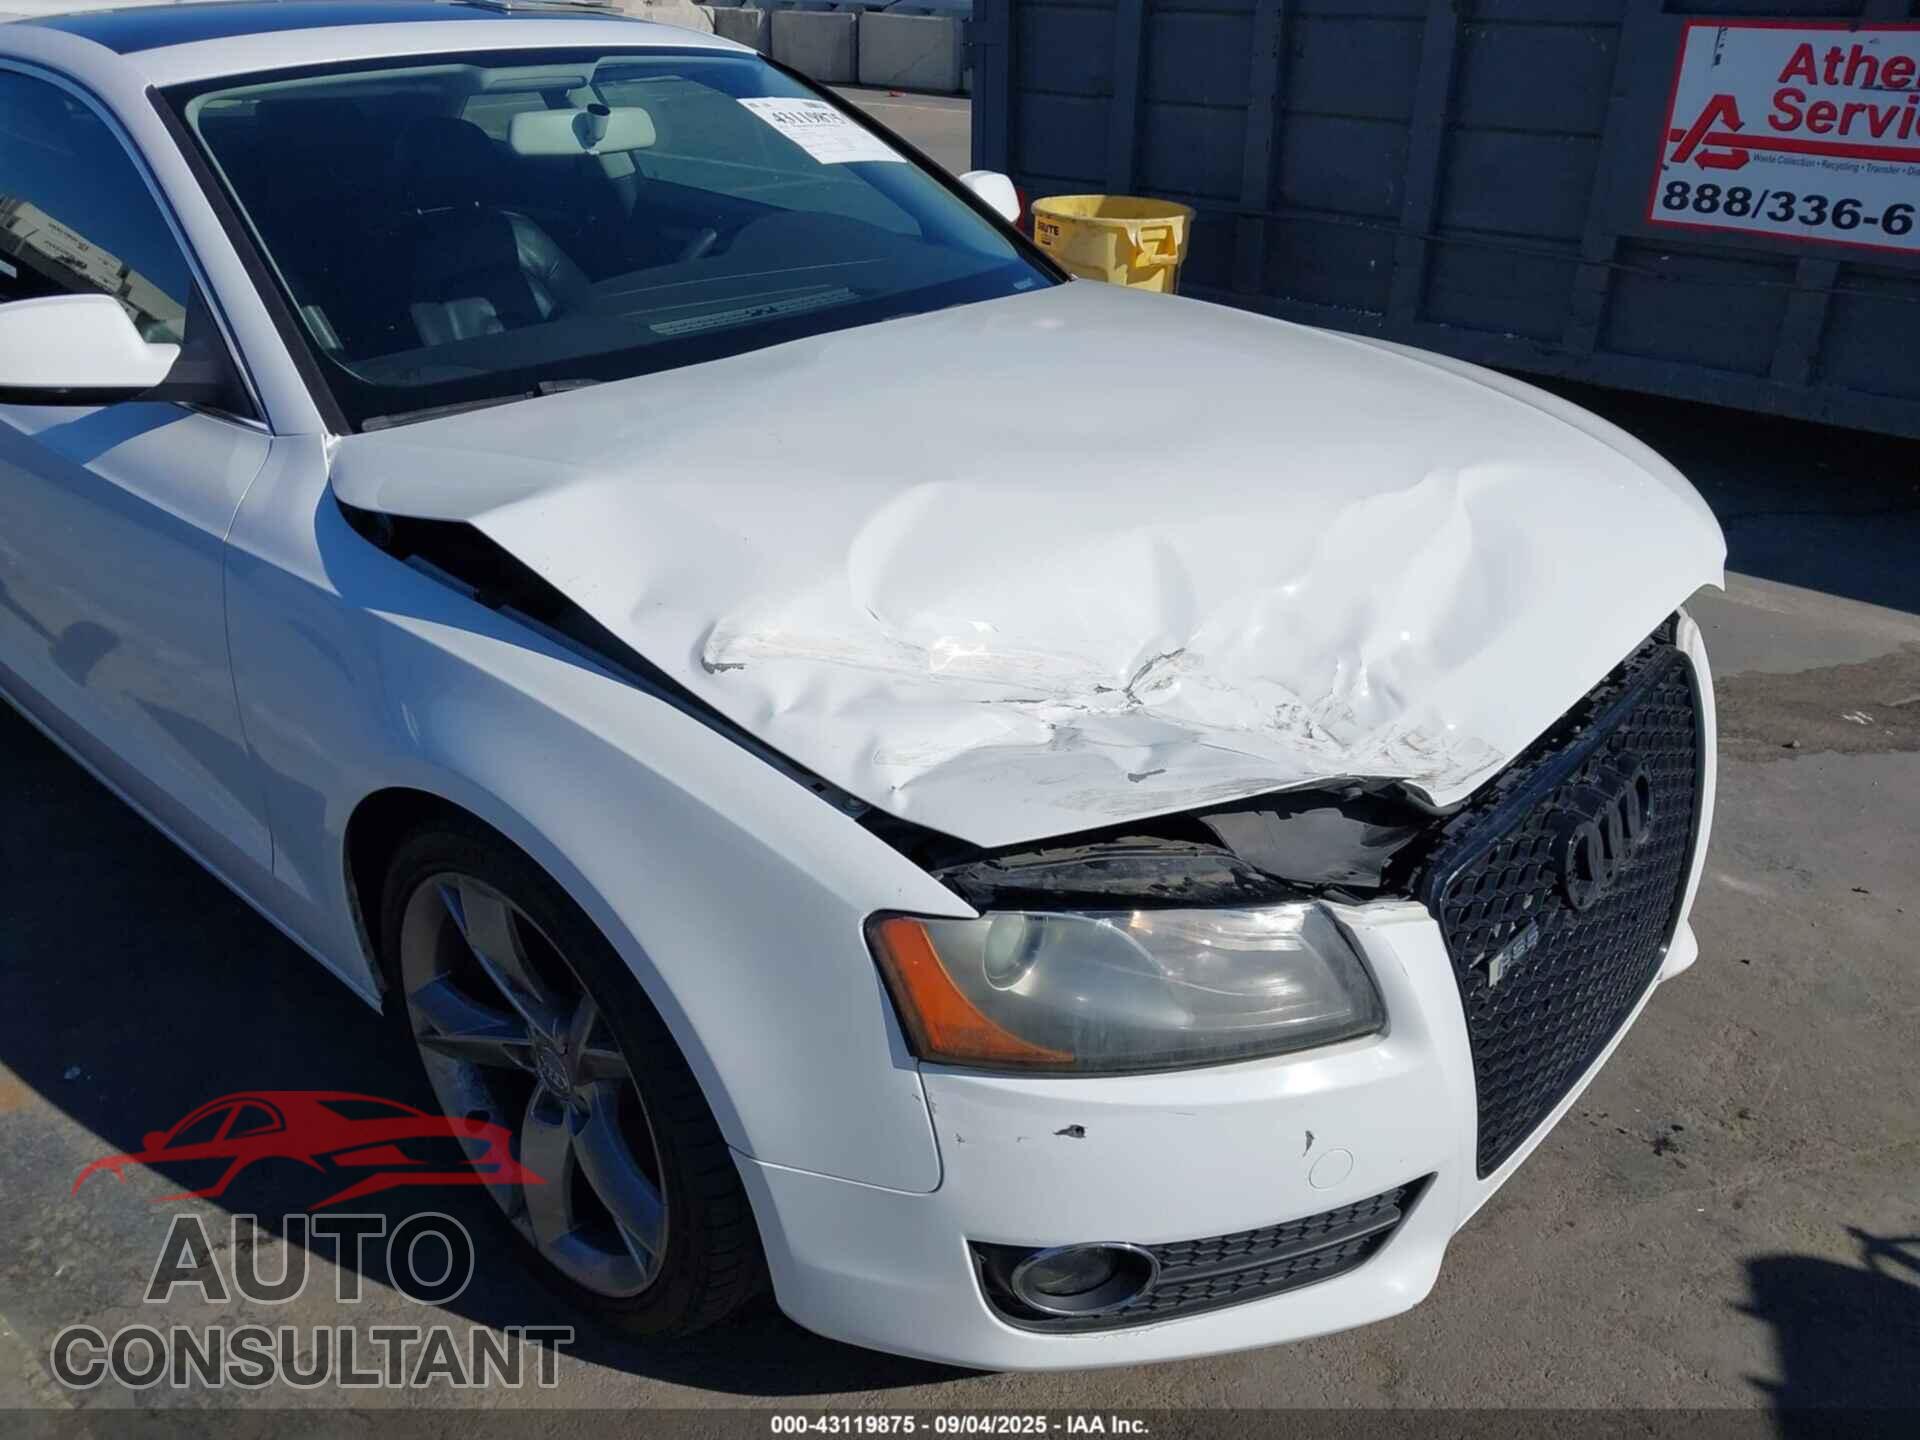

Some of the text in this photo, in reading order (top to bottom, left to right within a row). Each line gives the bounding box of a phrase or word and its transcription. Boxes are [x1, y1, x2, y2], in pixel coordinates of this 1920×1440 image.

[1778, 42, 1920, 90] Athe
[1768, 87, 1920, 140] Servi
[1662, 180, 1915, 236] 888/336-6
